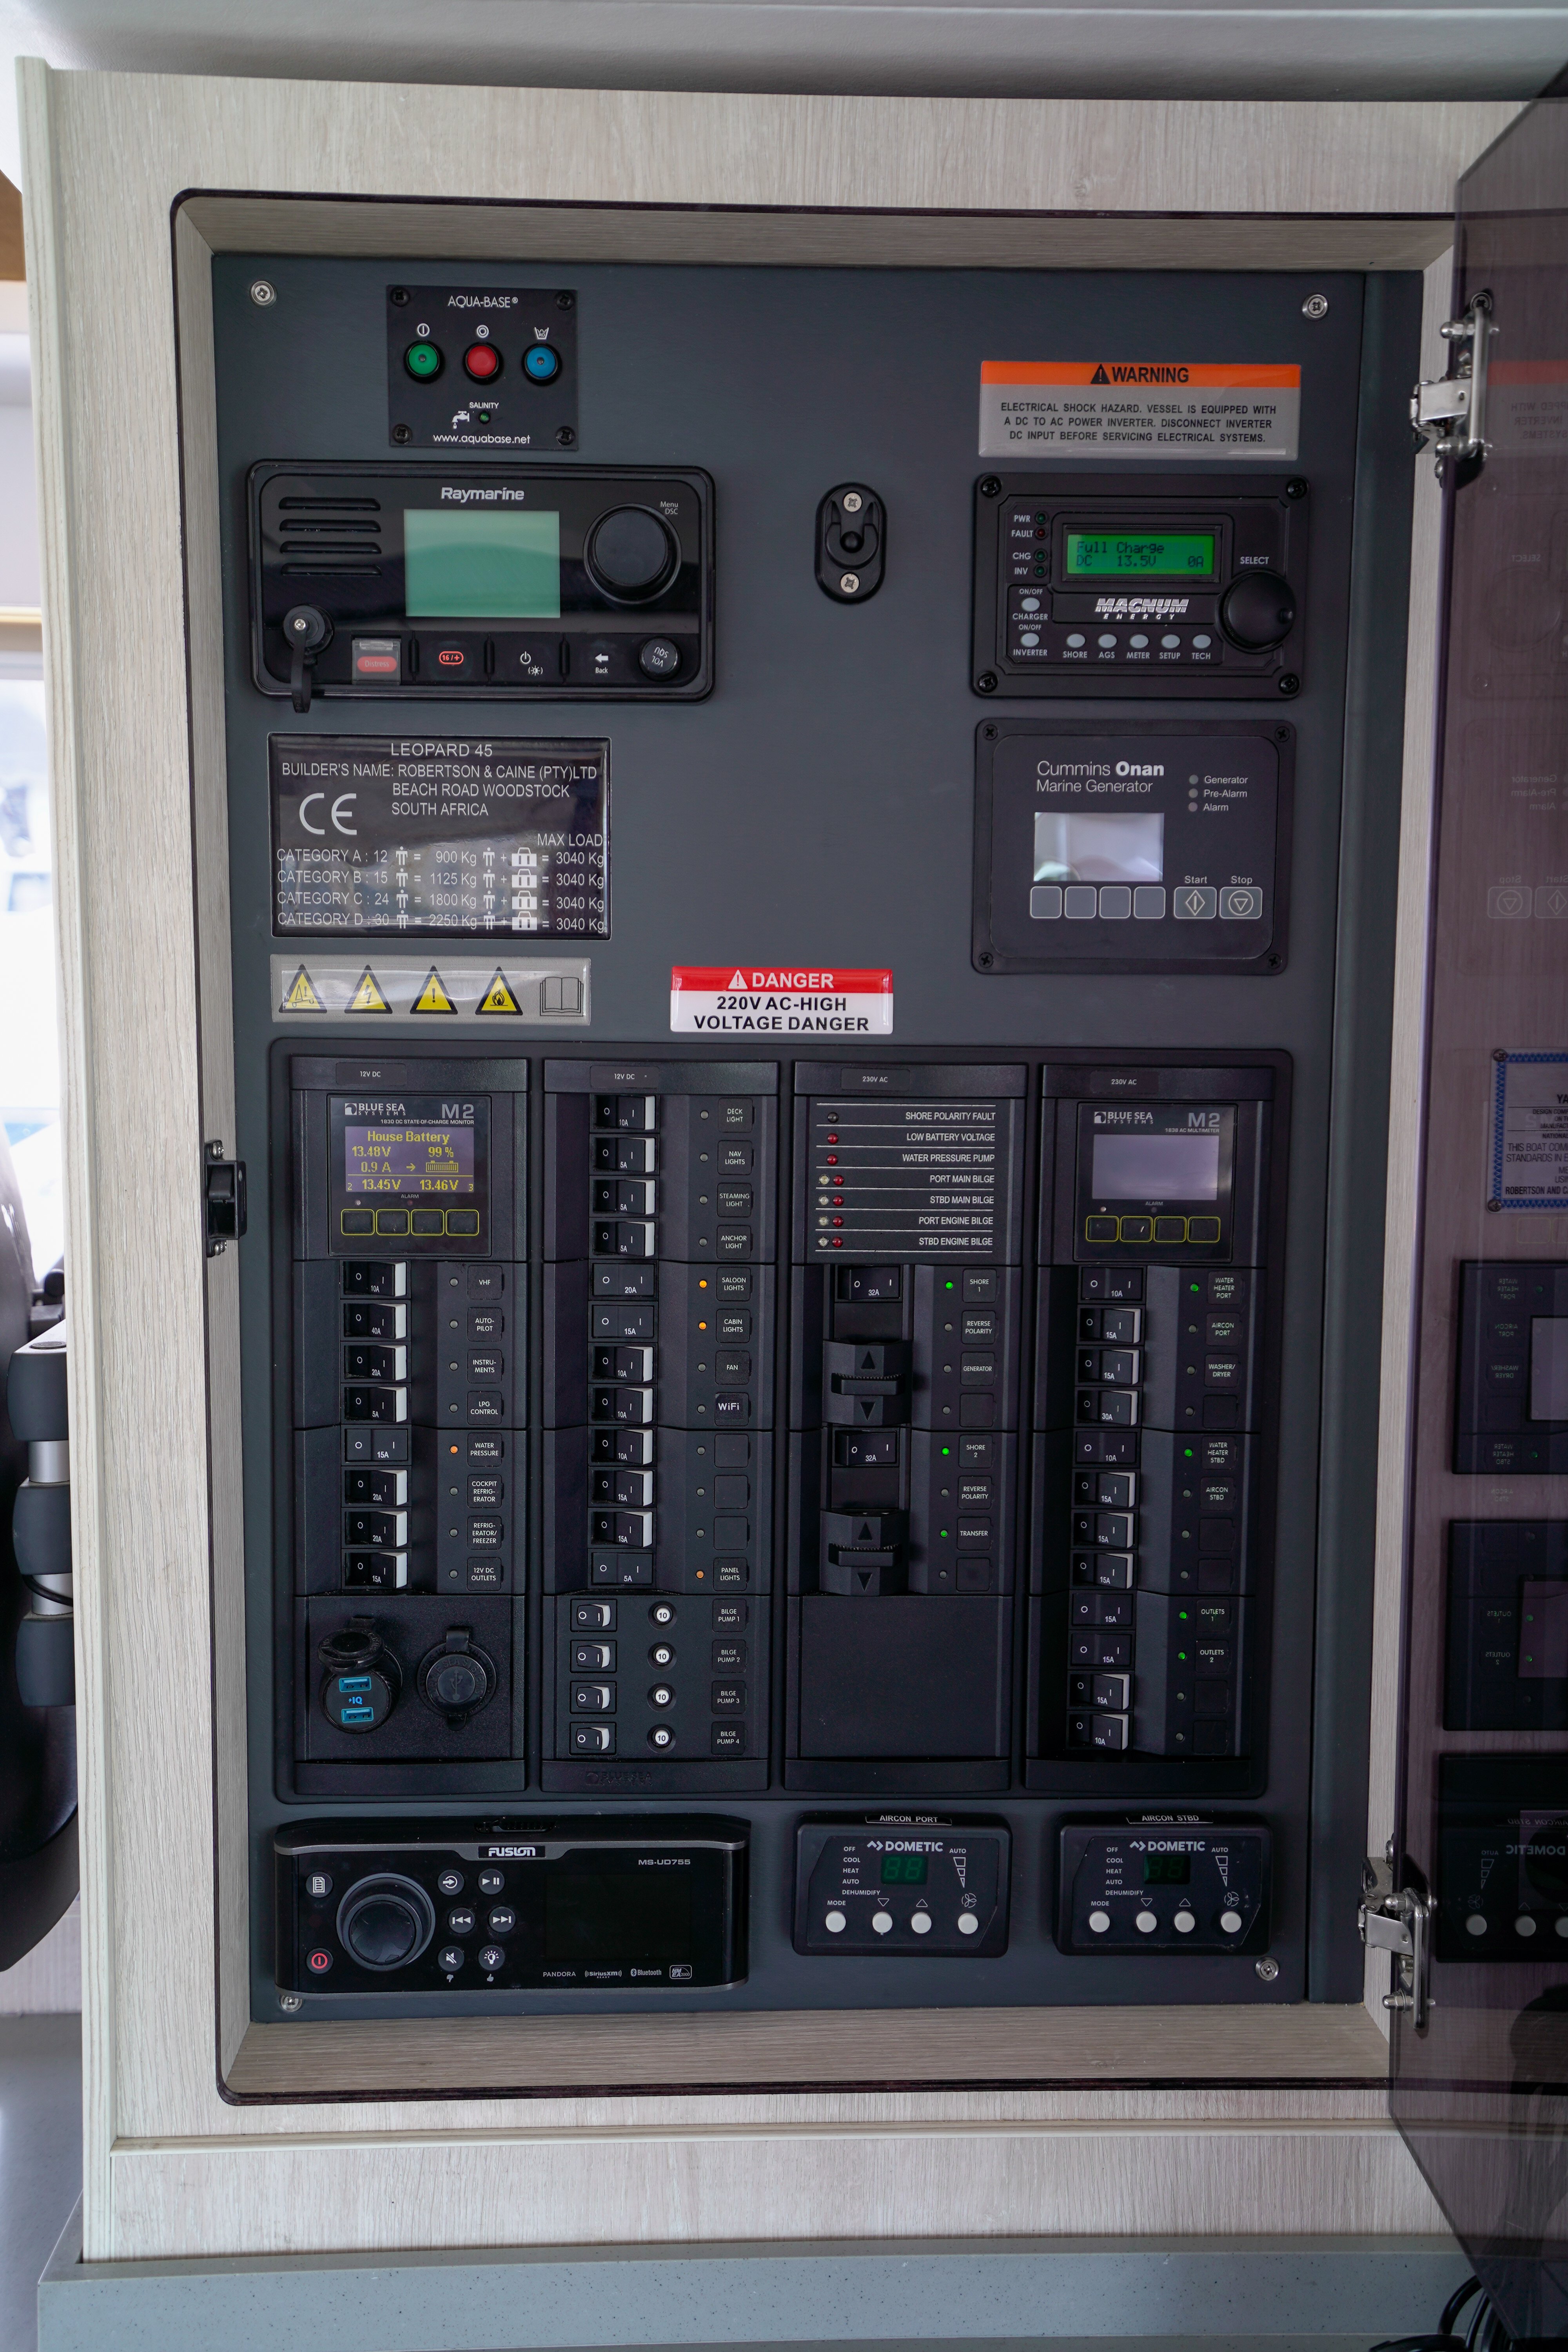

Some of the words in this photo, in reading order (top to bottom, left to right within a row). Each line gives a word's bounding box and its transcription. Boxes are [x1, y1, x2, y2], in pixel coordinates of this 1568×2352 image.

[1112, 367, 1189, 383] WARNING
[1002, 403, 1058, 411] ELECTRICAL
[1064, 404, 1096, 412] SHOCK
[1102, 404, 1142, 413] HAZARD.
[1147, 405, 1182, 413] VESSEL
[1188, 405, 1196, 413] IS
[1202, 405, 1248, 414] EQUIPPED
[1253, 406, 1276, 414] WITH
[1034, 417, 1045, 425] TO
[1069, 417, 1102, 426] POWER
[1108, 418, 1156, 426] INVERTER.
[1162, 419, 1221, 427] DISCONNECT
[433, 434, 530, 444] www.aquabase.net
[1010, 431, 1022, 439] DC
[1028, 431, 1055, 439] INPUT
[1060, 432, 1097, 440] BEFORE
[1103, 432, 1152, 441] SERVICING
[1158, 433, 1215, 441] ELECTRICAL
[1220, 434, 1265, 442] SYSTEMS.
[441, 487, 524, 503] Raymarine
[1078, 541, 1107, 554] Full
[1117, 542, 1164, 554] Charge
[1077, 555, 1092, 566] DC
[1118, 555, 1156, 567] 13.5V
[1095, 598, 1189, 613] MAGNUM
[652, 655, 663, 666] VOL
[392, 743, 469, 756] LEOPARD
[475, 744, 492, 757] 45
[283, 763, 349, 776] BUILDER'S
[354, 764, 393, 776] NAME:
[399, 764, 479, 777] ROBERTSON
[484, 765, 492, 778] &
[497, 766, 535, 778] CAINE
[540, 766, 596, 781] (PTY)LTD
[1038, 761, 1110, 776] Cummins
[1116, 761, 1164, 776] Onan
[1037, 779, 1081, 792] Marine
[1086, 779, 1153, 792] Generator
[1205, 775, 1248, 784] Generator
[393, 783, 437, 795] BEACH
[442, 784, 479, 796] ROAD
[483, 784, 569, 797] WOODSTOCK
[299, 793, 357, 835] CE
[392, 802, 436, 815] SOUTH
[441, 803, 488, 815] AFRICA
[538, 833, 564, 846] MAX
[569, 834, 603, 846] LOAD
[277, 849, 348, 864] CATEGORY
[353, 849, 361, 862] A
[374, 850, 387, 862] 12
[436, 851, 457, 863] 900
[462, 851, 476, 866] Kg
[556, 852, 584, 864] 3040
[589, 853, 604, 867] Kg
[1231, 876, 1252, 885] Stop
[753, 973, 833, 988] DANGER
[717, 996, 761, 1009] 220V
[766, 997, 846, 1011] AC-HIGH
[694, 1016, 782, 1029] VOLTAGE
[789, 1017, 869, 1031] DANGER
[368, 1131, 403, 1141] House
[406, 1131, 450, 1145] Battery
[428, 1147, 442, 1157] 99
[1526, 1143, 1547, 1151] BOAT
[1506, 1154, 1552, 1162] STANDARDS
[382, 1162, 391, 1172] A
[886, 1841, 943, 1851] DOMETIC
